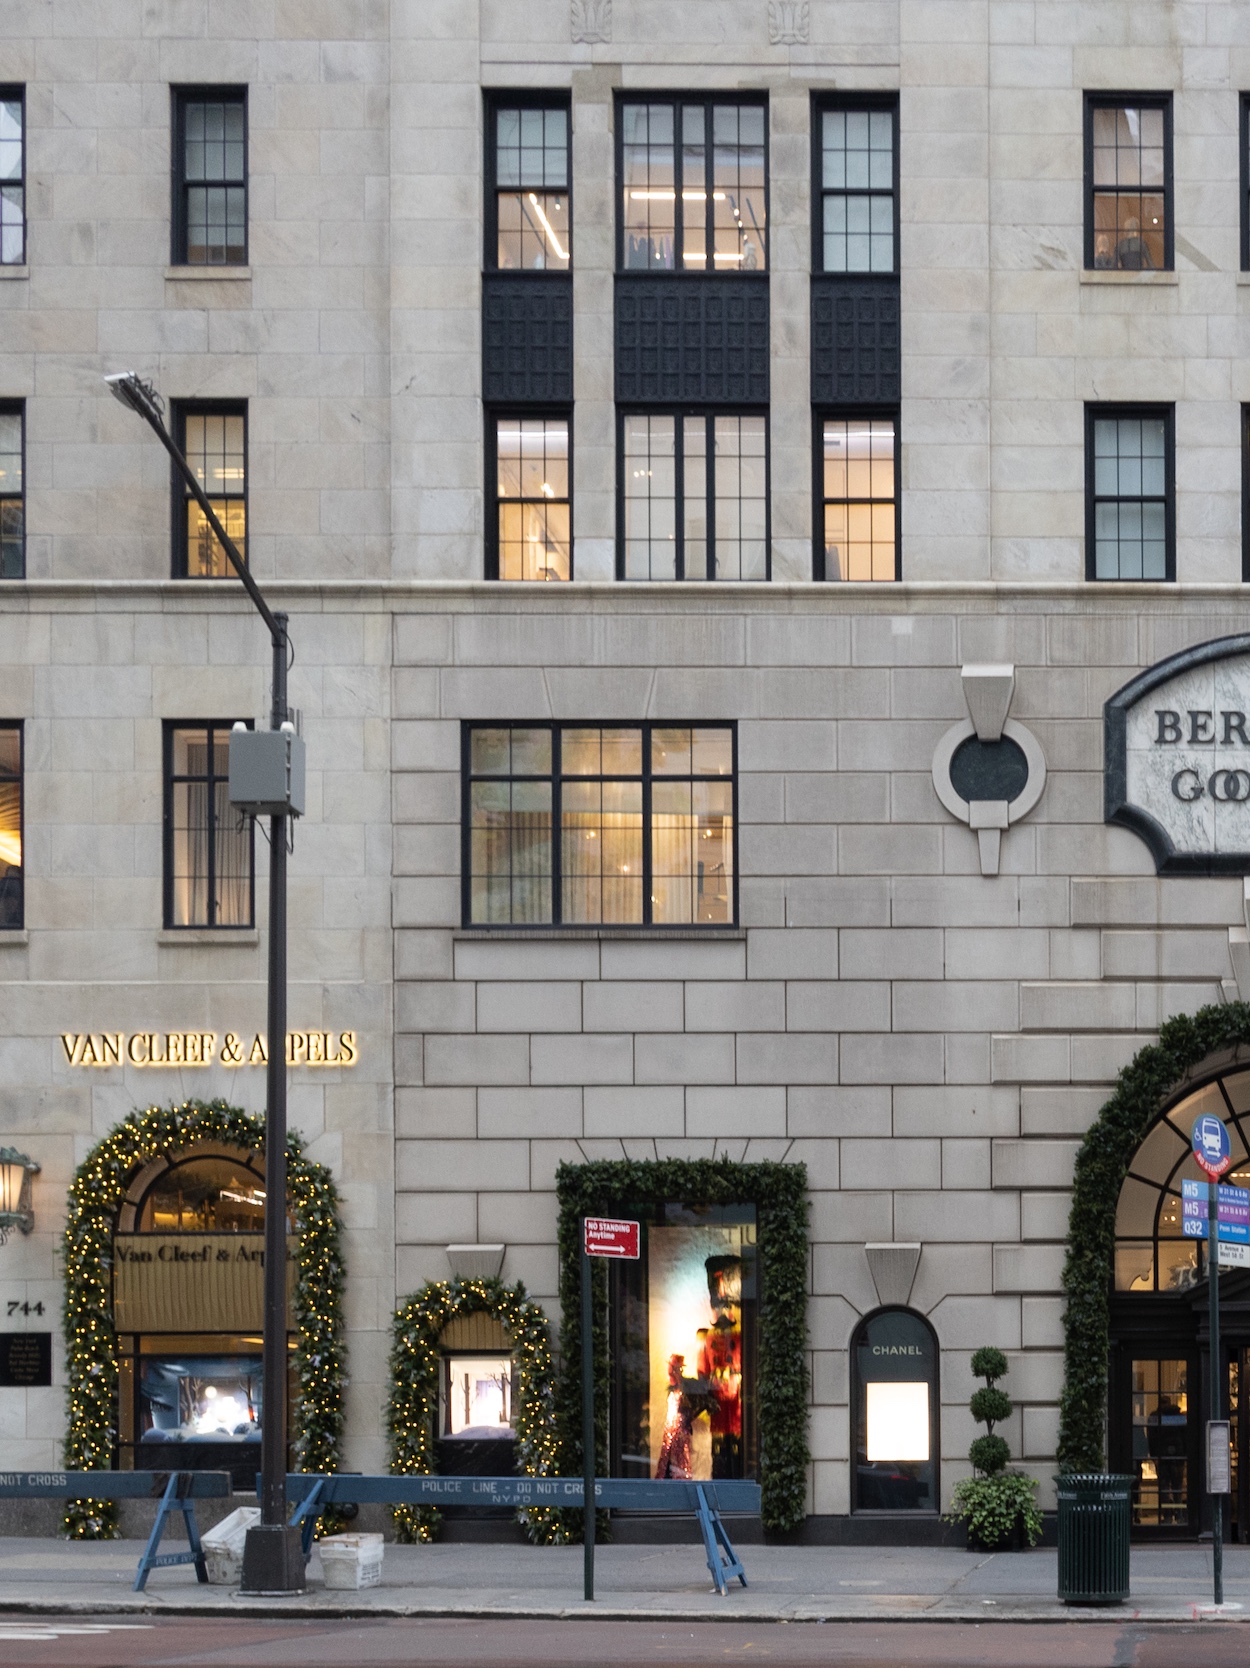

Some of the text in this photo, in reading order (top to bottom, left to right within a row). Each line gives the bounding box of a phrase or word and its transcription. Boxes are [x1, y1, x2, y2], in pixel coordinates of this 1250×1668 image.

[60, 1033, 356, 1063] VAN CLEEF & APELS
[1184, 1183, 1199, 1197] M5
[1184, 1201, 1199, 1216] M5
[588, 1222, 630, 1233] NO STANDING
[1184, 1220, 1203, 1236] Q32
[588, 1231, 615, 1241] Anytime
[116, 1245, 152, 1262] Van
[158, 1245, 212, 1262] Cleef
[216, 1248, 229, 1262] &
[7, 1301, 45, 1316] 744
[872, 1345, 922, 1356] CHANEL
[0, 1473, 67, 1486] NOT CROSS
[421, 1480, 462, 1493] POLICE
[472, 1481, 497, 1493] LINE
[516, 1482, 532, 1494] DO
[536, 1482, 559, 1494] NOT
[563, 1483, 602, 1495] CROS
[492, 1494, 531, 1504] NYPD
